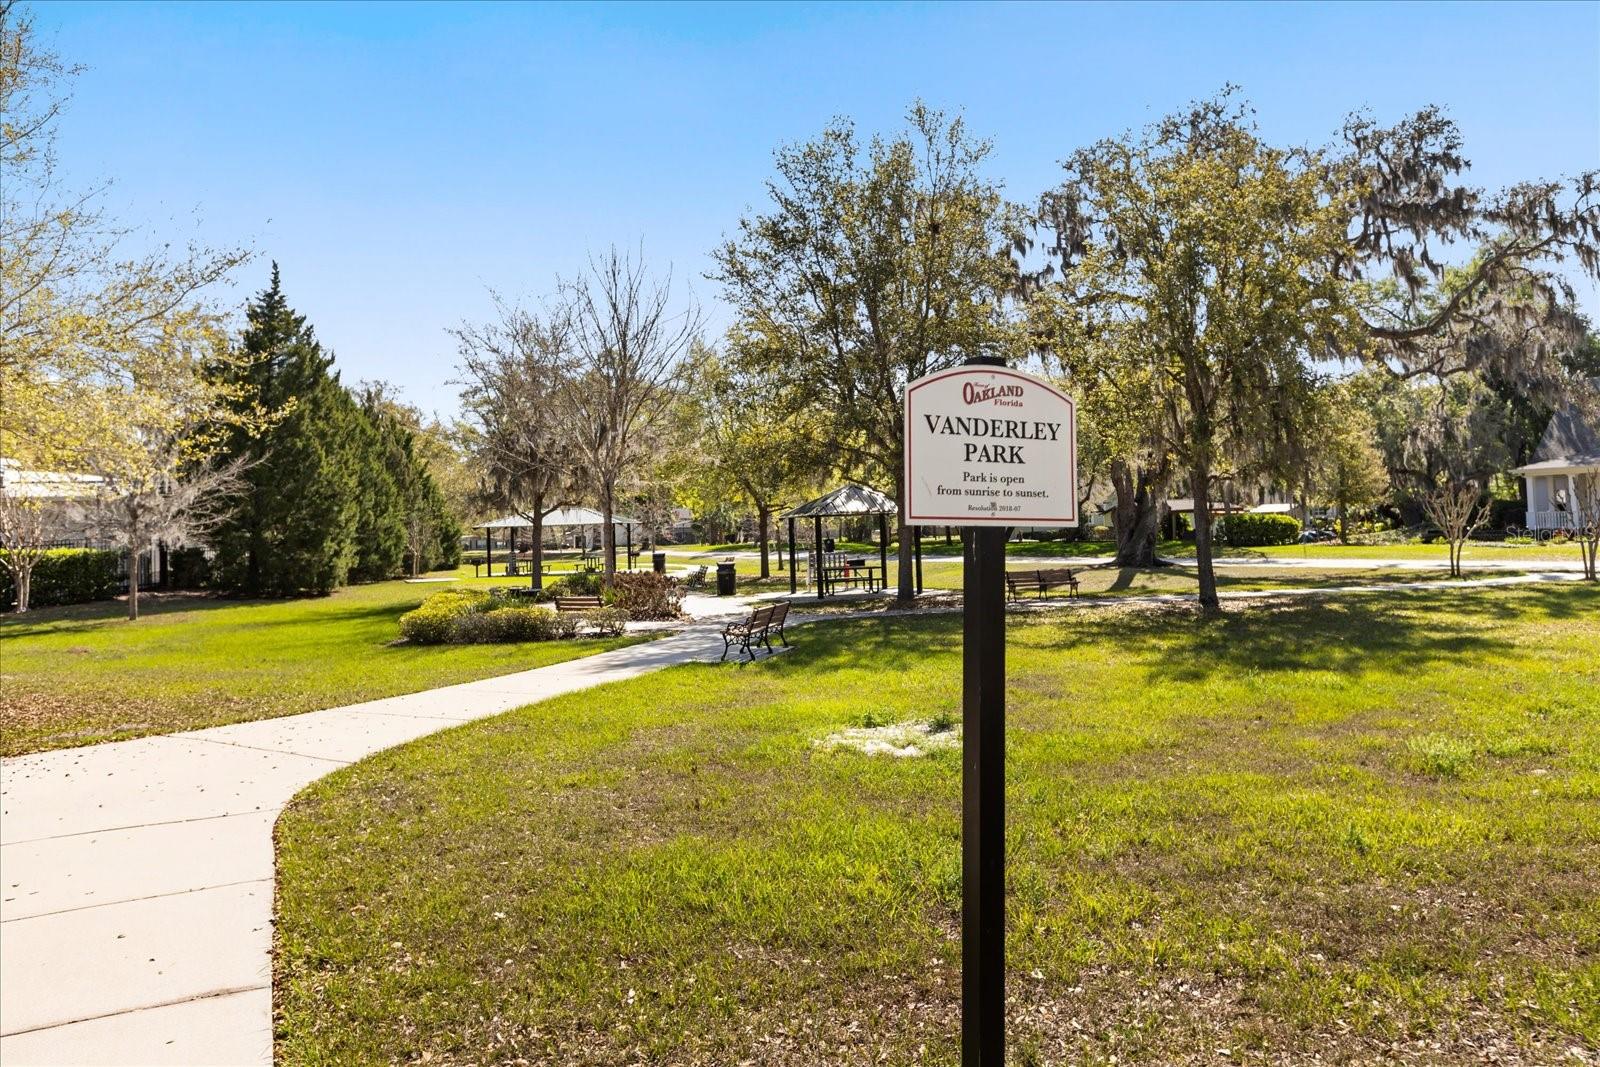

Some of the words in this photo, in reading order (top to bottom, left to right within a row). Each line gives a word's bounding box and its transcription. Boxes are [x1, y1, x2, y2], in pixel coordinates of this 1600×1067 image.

[963, 382, 1024, 405] OAKLAND
[994, 399, 1023, 407] Florida
[924, 414, 1061, 440] VANDERLEY
[963, 443, 1026, 464] PARK
[963, 471, 987, 482] Park
[989, 473, 998, 483] is
[1000, 476, 1025, 486] open
[937, 484, 962, 496] from
[964, 486, 1001, 497] sunrise
[1003, 488, 1013, 497] to
[1015, 489, 1049, 498] sunset.
